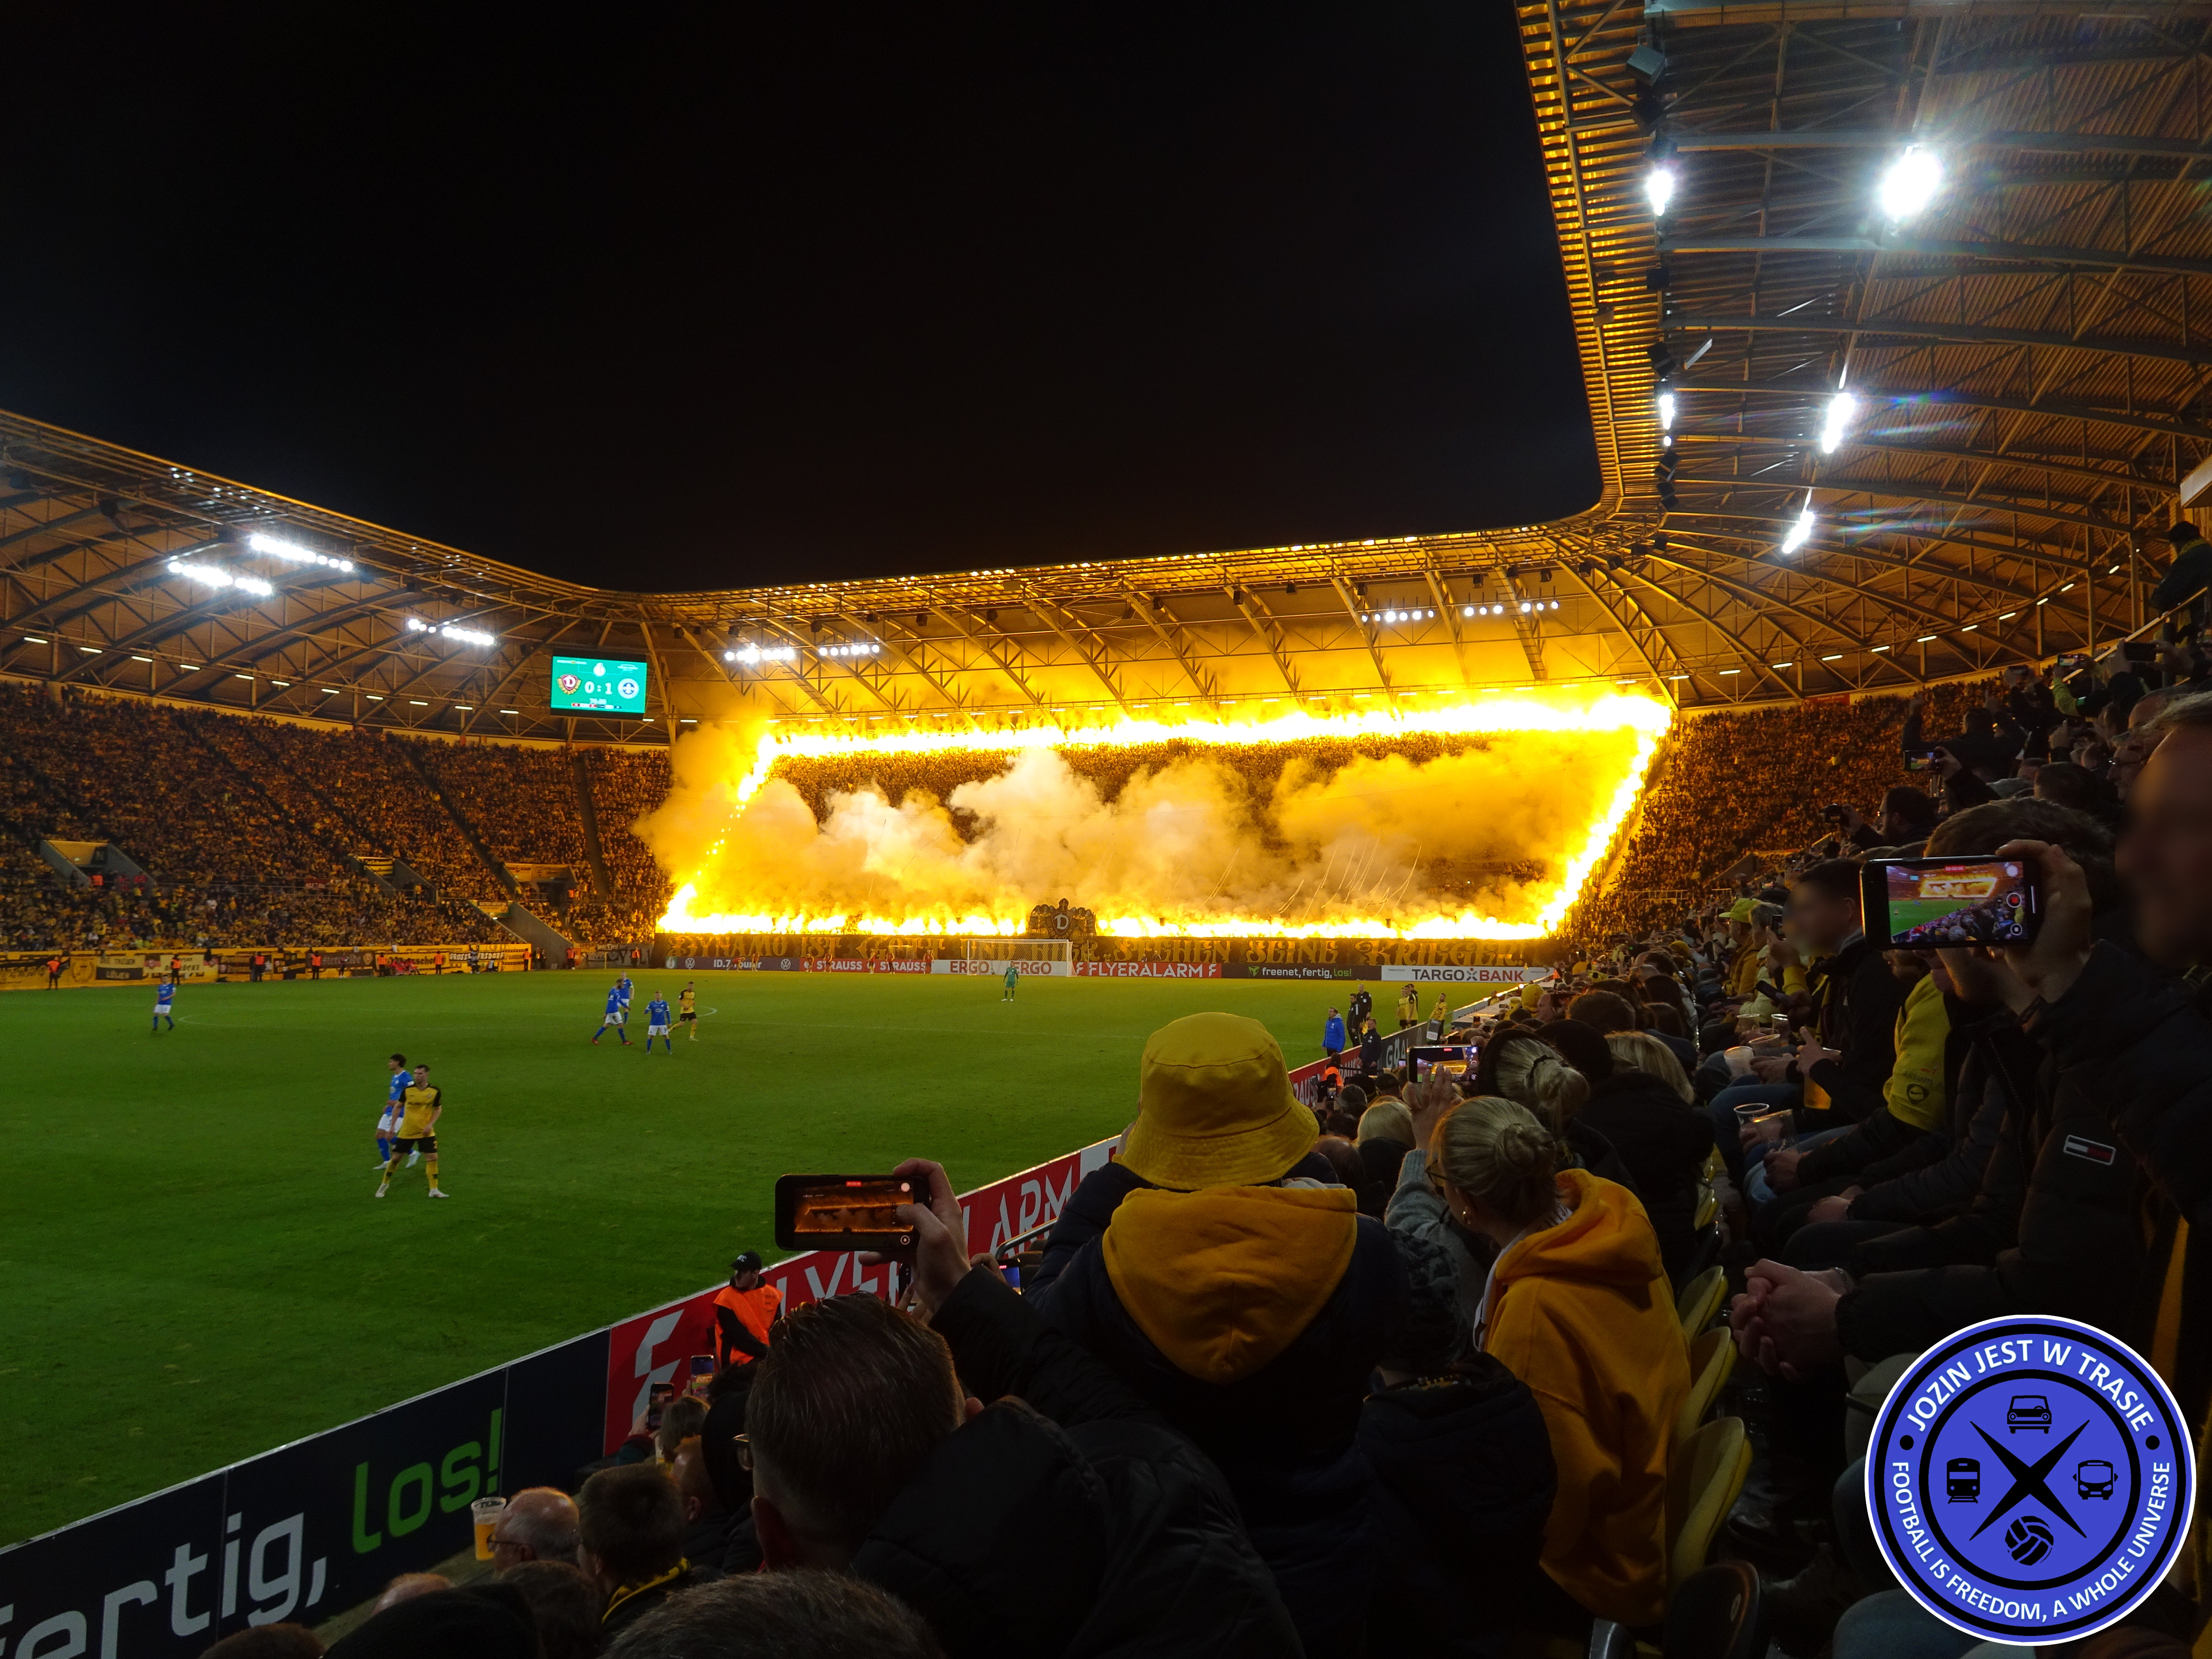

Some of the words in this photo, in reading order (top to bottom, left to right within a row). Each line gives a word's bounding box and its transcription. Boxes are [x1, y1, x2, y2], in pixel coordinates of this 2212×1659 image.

[713, 959, 731, 968] ID.7
[950, 961, 989, 974] ERGO
[1089, 962, 1203, 978] FLYERALARM
[1262, 967, 1301, 978] freenet,
[1302, 968, 1332, 979] fertig,
